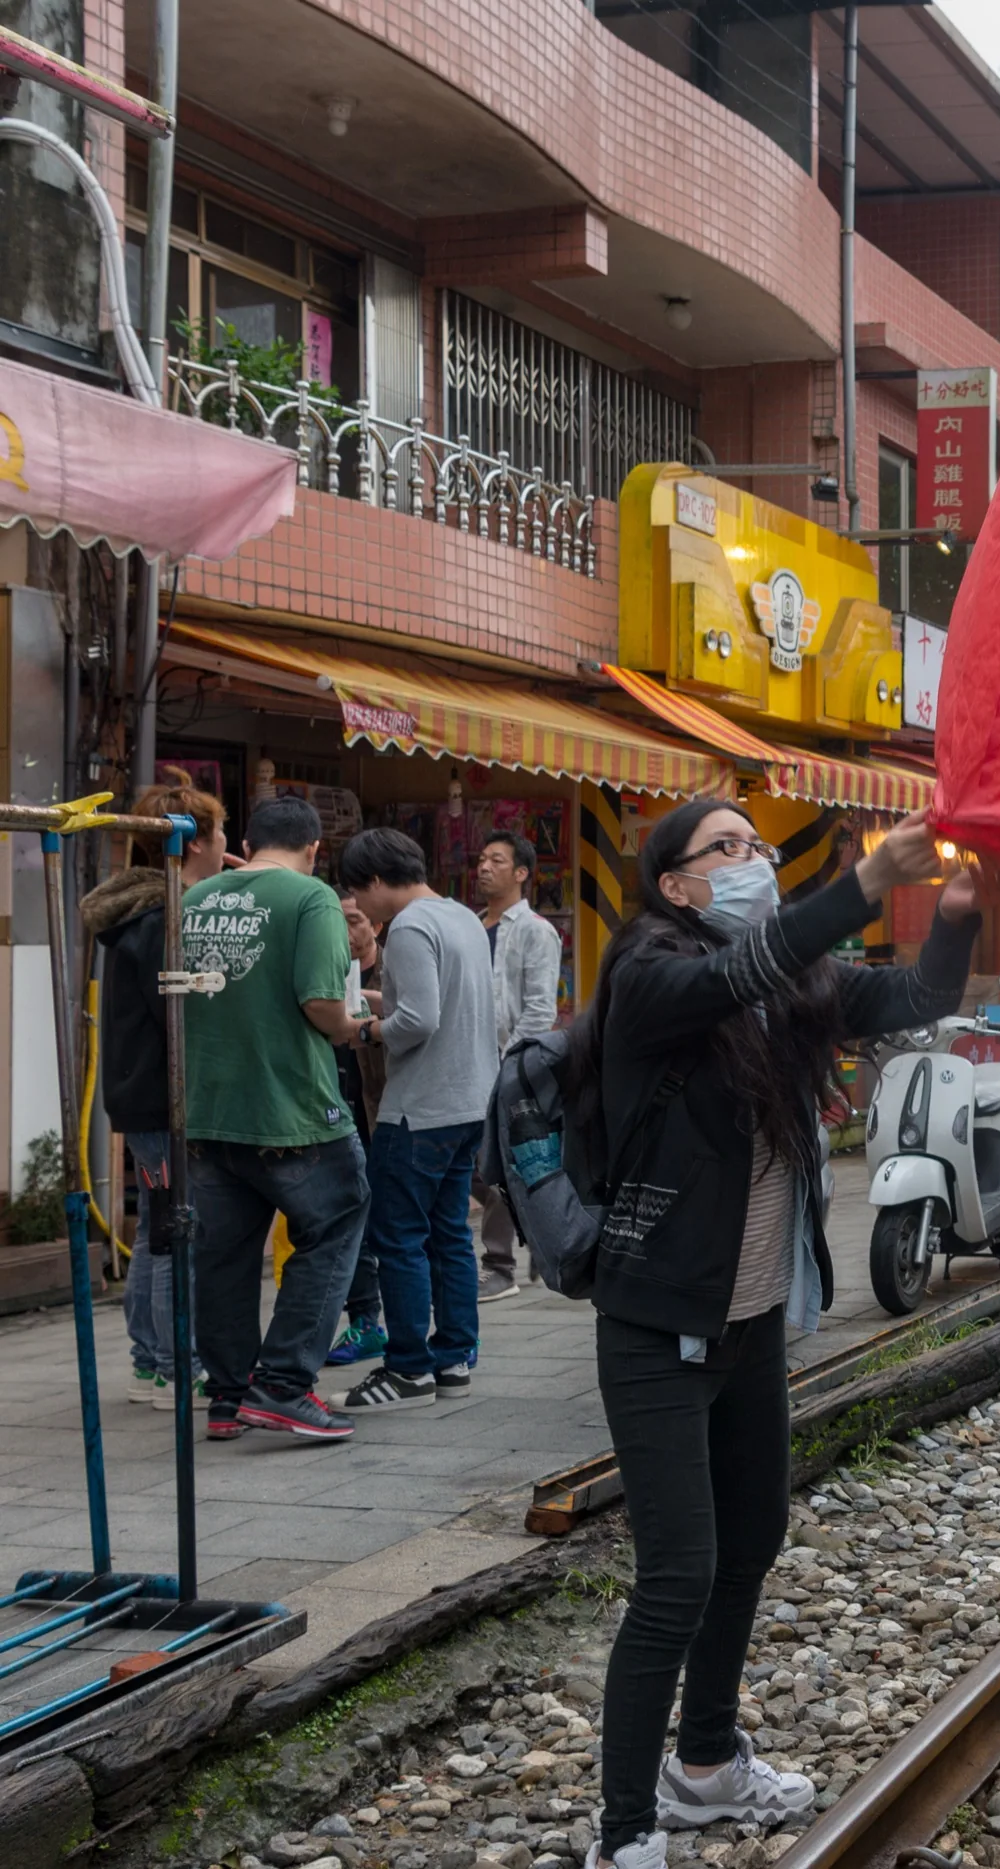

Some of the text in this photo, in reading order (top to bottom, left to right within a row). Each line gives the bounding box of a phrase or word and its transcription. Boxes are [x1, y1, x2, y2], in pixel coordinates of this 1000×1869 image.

[919, 379, 988, 401] 十分好吃
[773, 651, 801, 669] DESIGN
[185, 934, 252, 944] IMPORTANT
